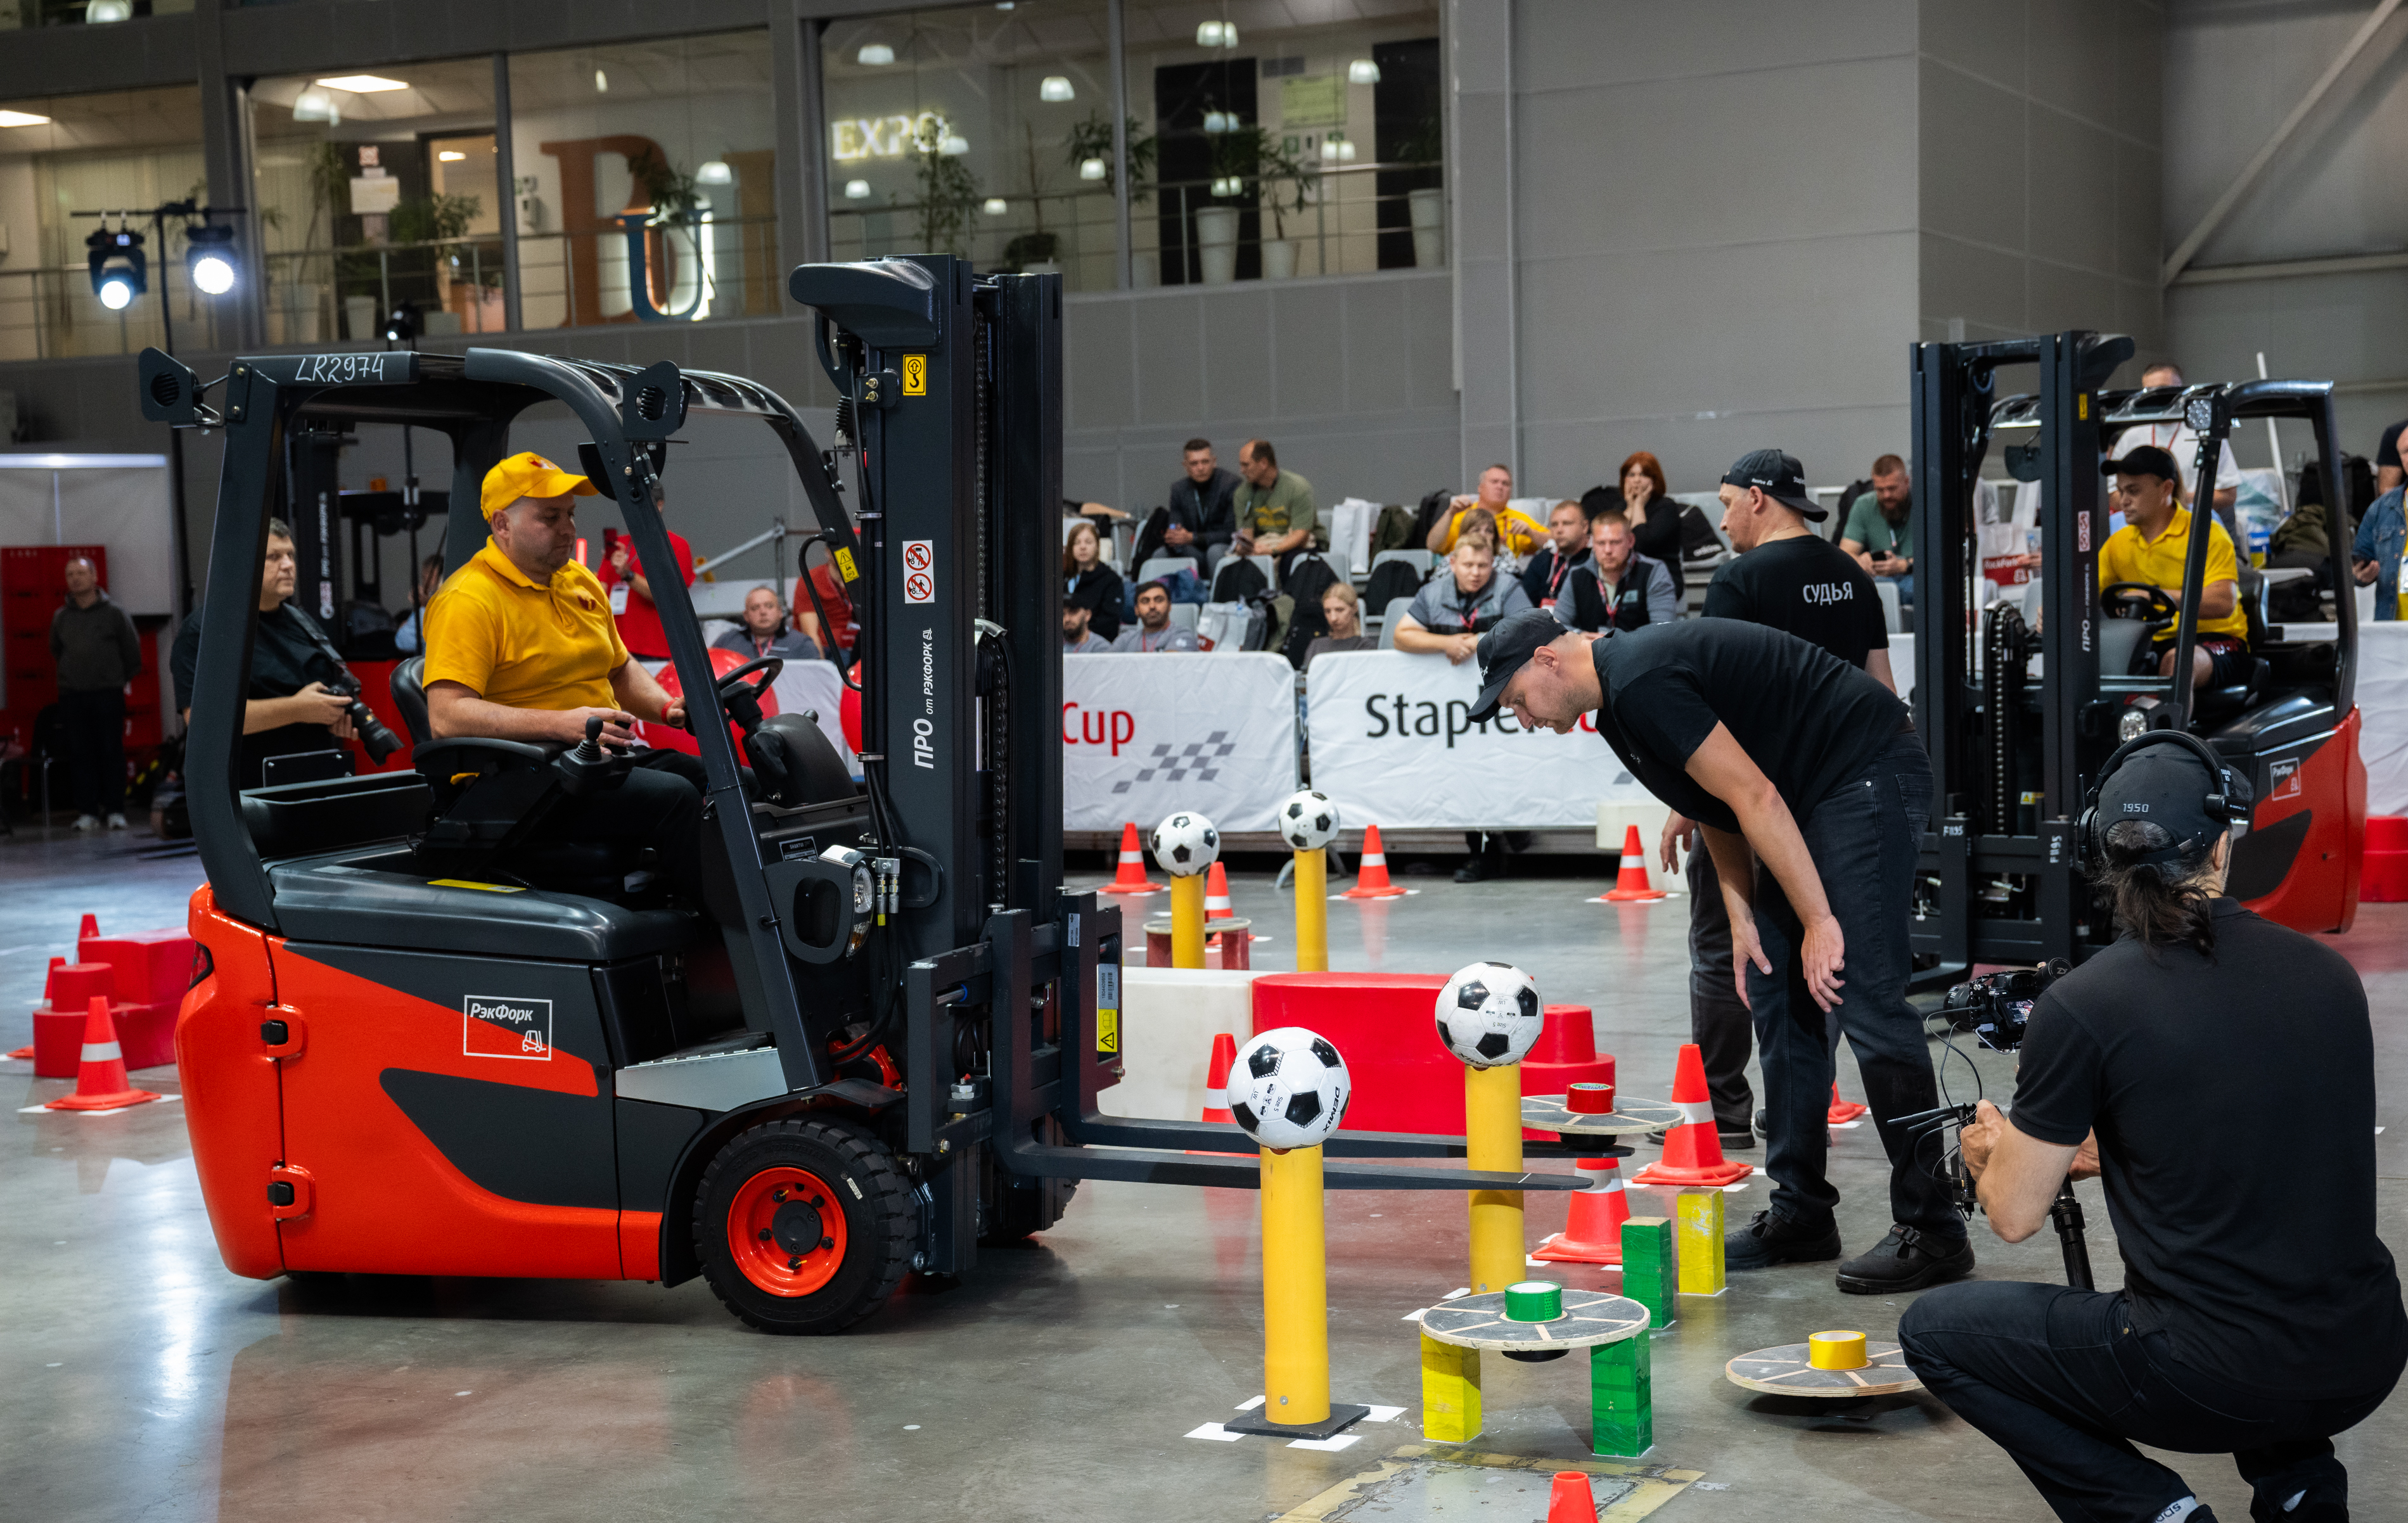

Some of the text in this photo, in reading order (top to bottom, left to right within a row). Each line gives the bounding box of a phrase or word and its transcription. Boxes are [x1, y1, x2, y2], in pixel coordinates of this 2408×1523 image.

[831, 111, 951, 160] EXPO
[295, 353, 384, 383] LR2974
[1803, 581, 1854, 606] СУДЬЯ
[913, 642, 934, 769] ПРО от РЭКФОРК
[1063, 701, 1135, 757] Cup
[2123, 803, 2149, 813] 1950
[470, 1002, 534, 1024] РэкФорк
[1253, 1090, 1259, 1100] LW
[1275, 1096, 1283, 1108] Size
[1322, 1086, 1340, 1133] DEMIX
